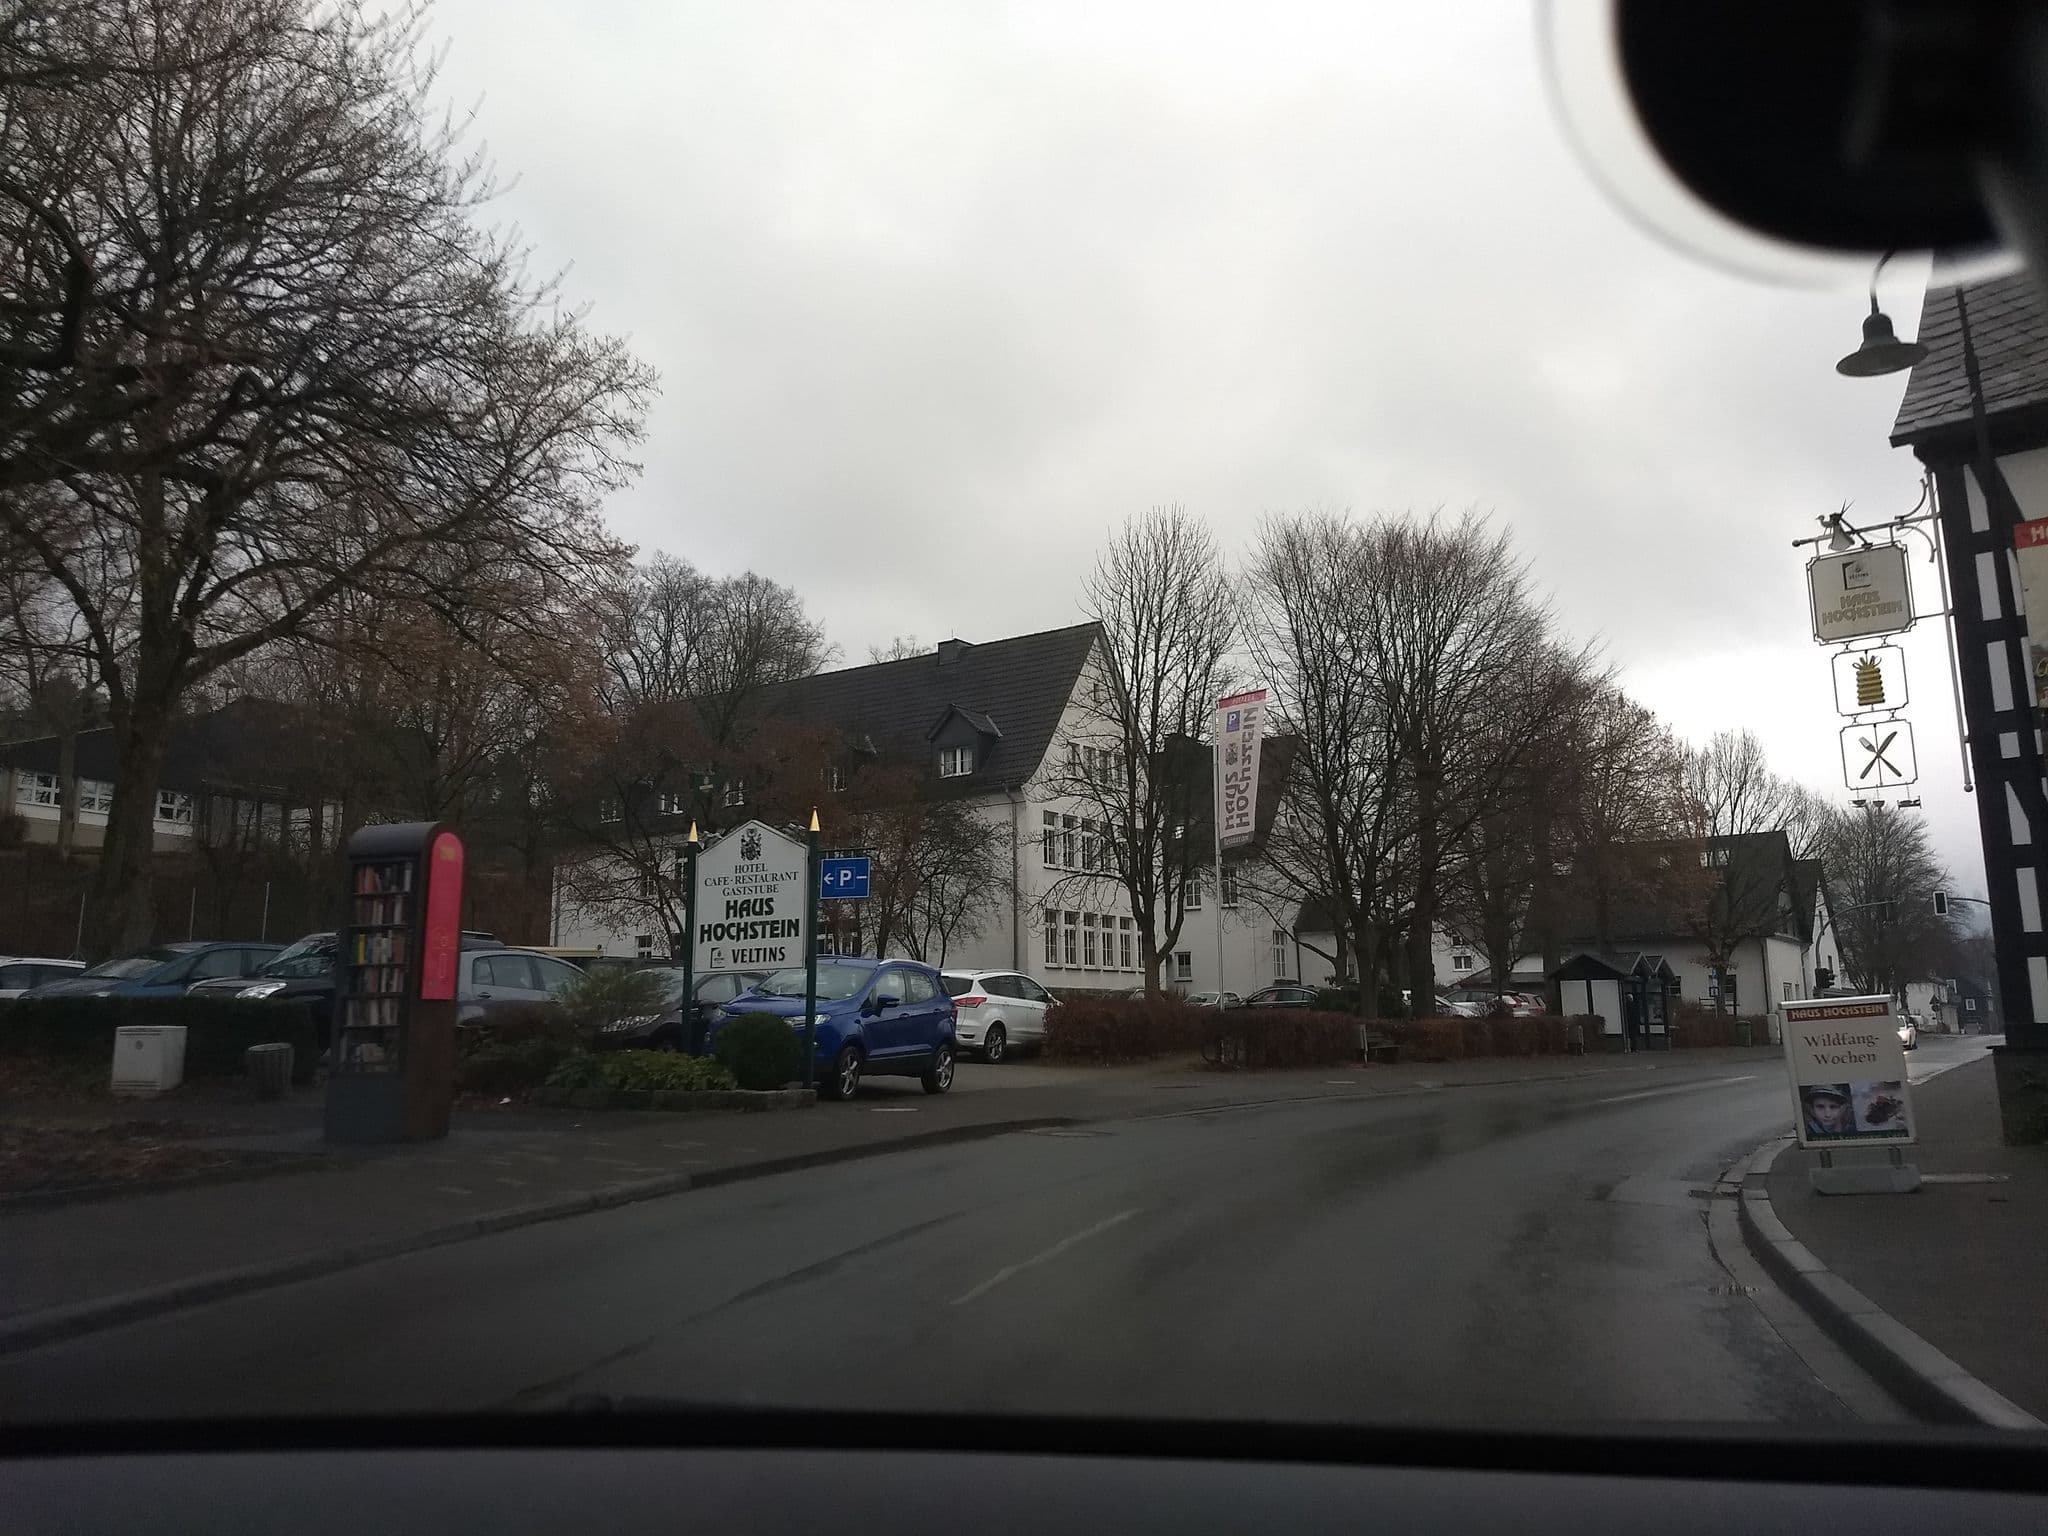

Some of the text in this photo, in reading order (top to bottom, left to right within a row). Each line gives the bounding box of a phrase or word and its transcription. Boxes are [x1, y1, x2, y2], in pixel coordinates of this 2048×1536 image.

[2031, 526, 2048, 544] H
[1822, 600, 1902, 625] HOCHSTEIN
[1236, 707, 1258, 829] HOCHSTEIN
[734, 863, 768, 875] HOTEL
[840, 869, 852, 887] P
[704, 872, 799, 887] CAFE RESTAURANT
[722, 883, 780, 897] GASTSTUBE
[725, 897, 774, 920] HAUS
[700, 918, 800, 945] HOCHSTEIN
[731, 946, 786, 964] VELTINS
[1791, 1004, 1884, 1020] HAUS HOCHSTEIN
[1803, 1032, 1880, 1048] Wildfang-
[1813, 1051, 1877, 1065] Wochen
